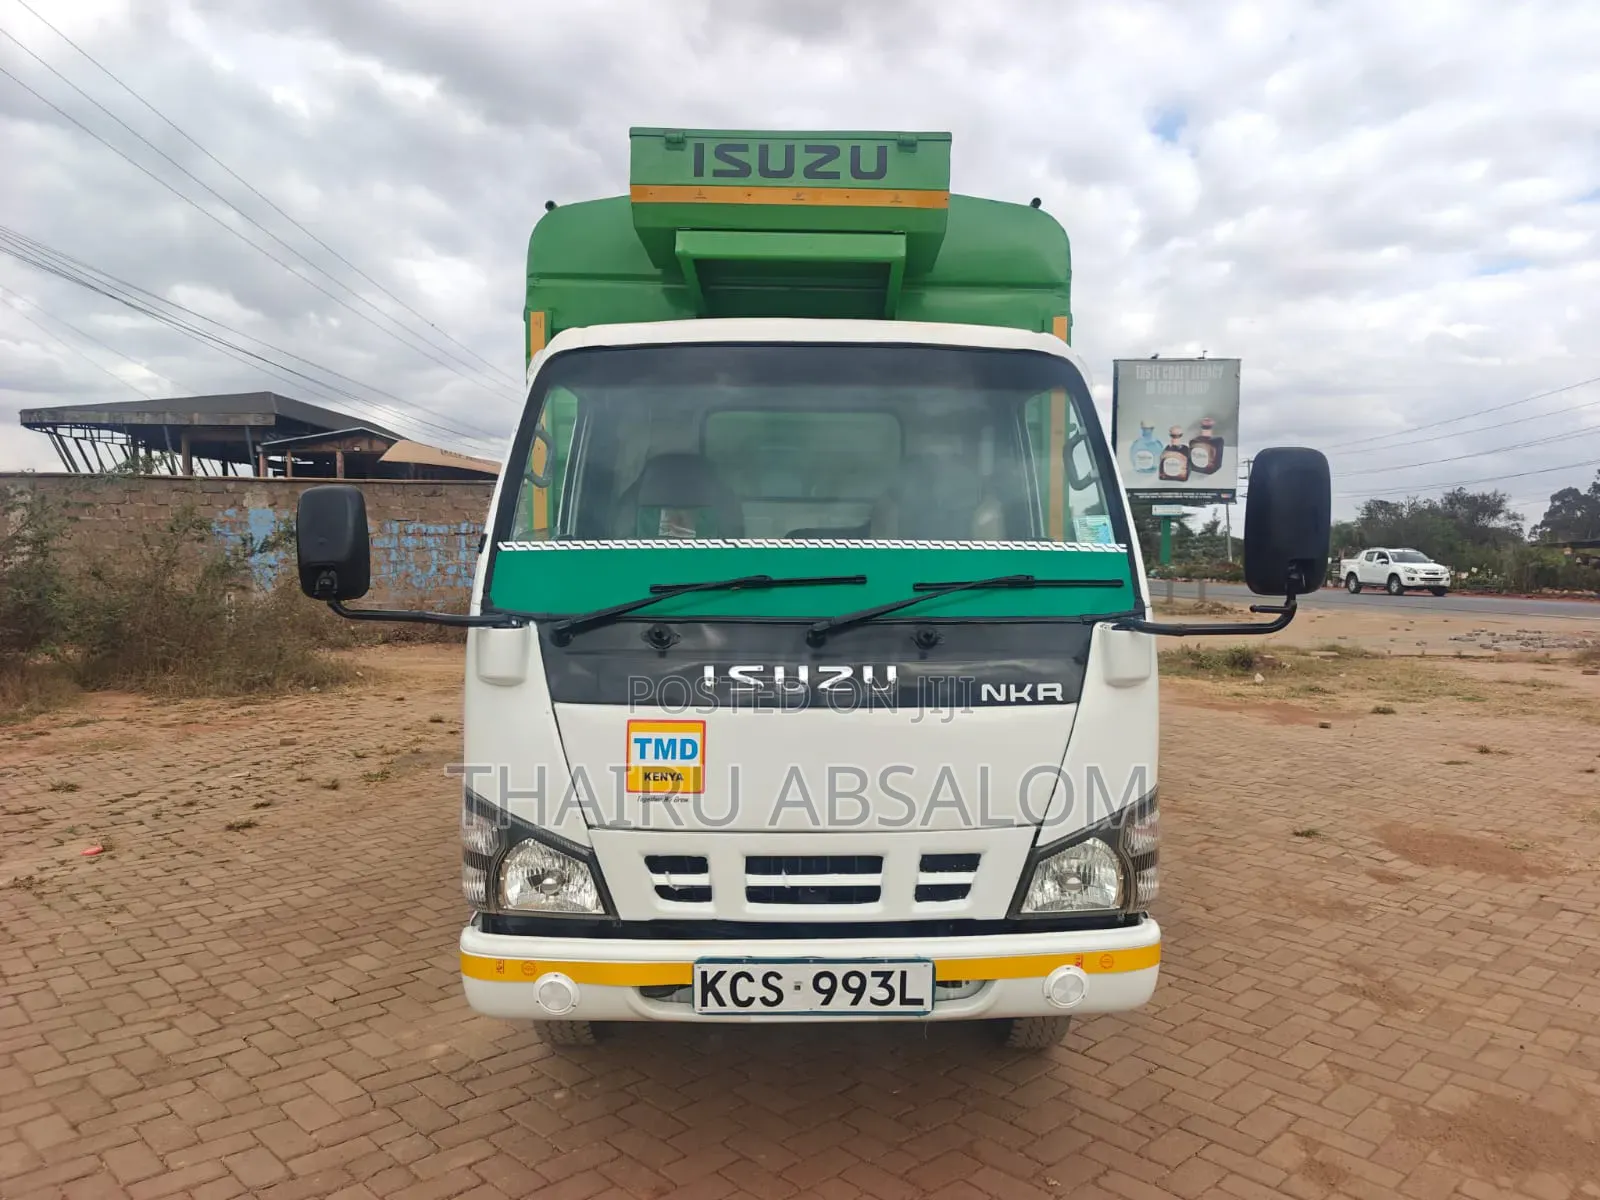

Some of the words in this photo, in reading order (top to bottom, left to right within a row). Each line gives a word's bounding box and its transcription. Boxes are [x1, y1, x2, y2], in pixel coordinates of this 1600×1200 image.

[694, 143, 887, 180] ISUZU
[703, 665, 898, 693] ISUZU
[981, 683, 1064, 702] NKR
[633, 738, 698, 760] TMD
[643, 772, 684, 782] KENYA
[700, 970, 784, 1007] KCS
[812, 970, 924, 1006] 993L
